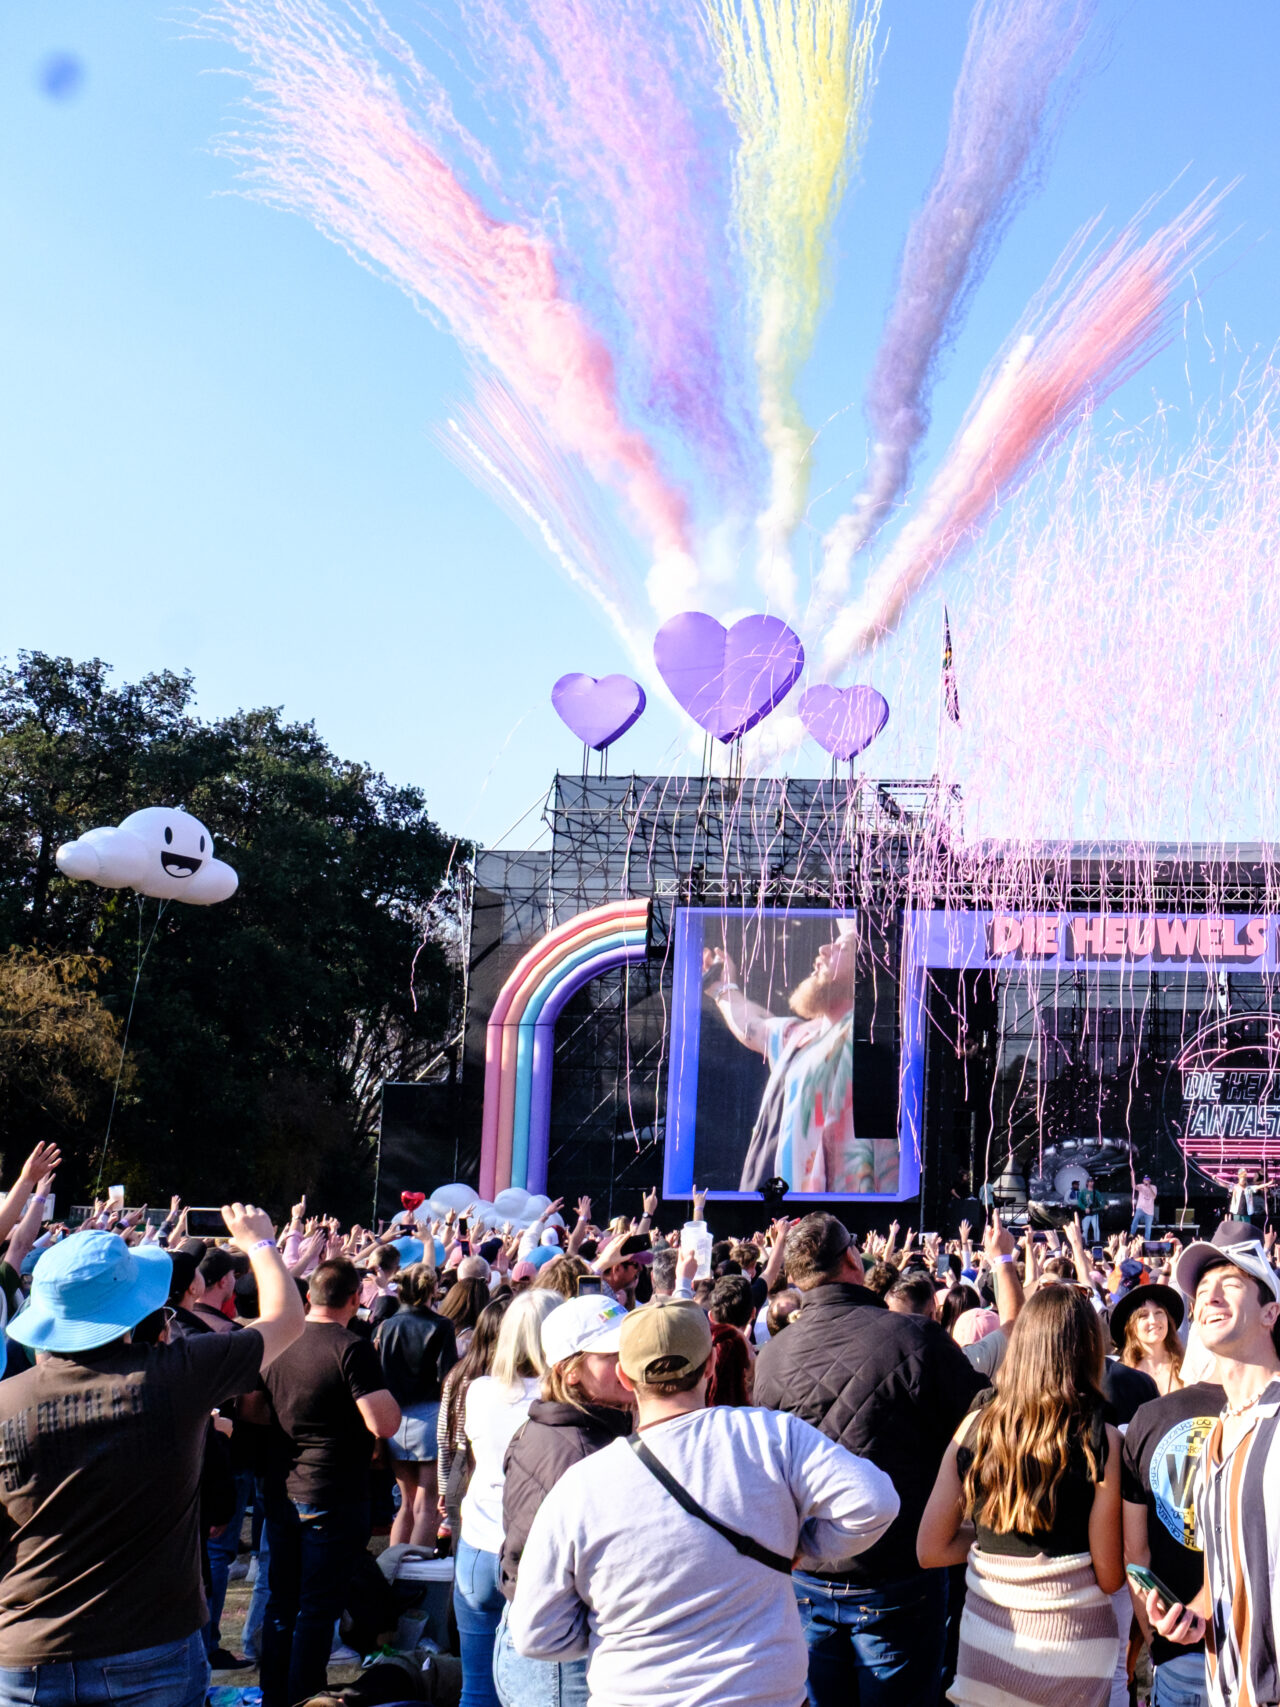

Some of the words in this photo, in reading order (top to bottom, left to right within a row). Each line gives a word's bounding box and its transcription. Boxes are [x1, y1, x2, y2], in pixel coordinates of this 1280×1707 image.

[988, 916, 1059, 956] DIE
[1068, 917, 1269, 960] HEUWELS
[1184, 1072, 1225, 1100] DIE
